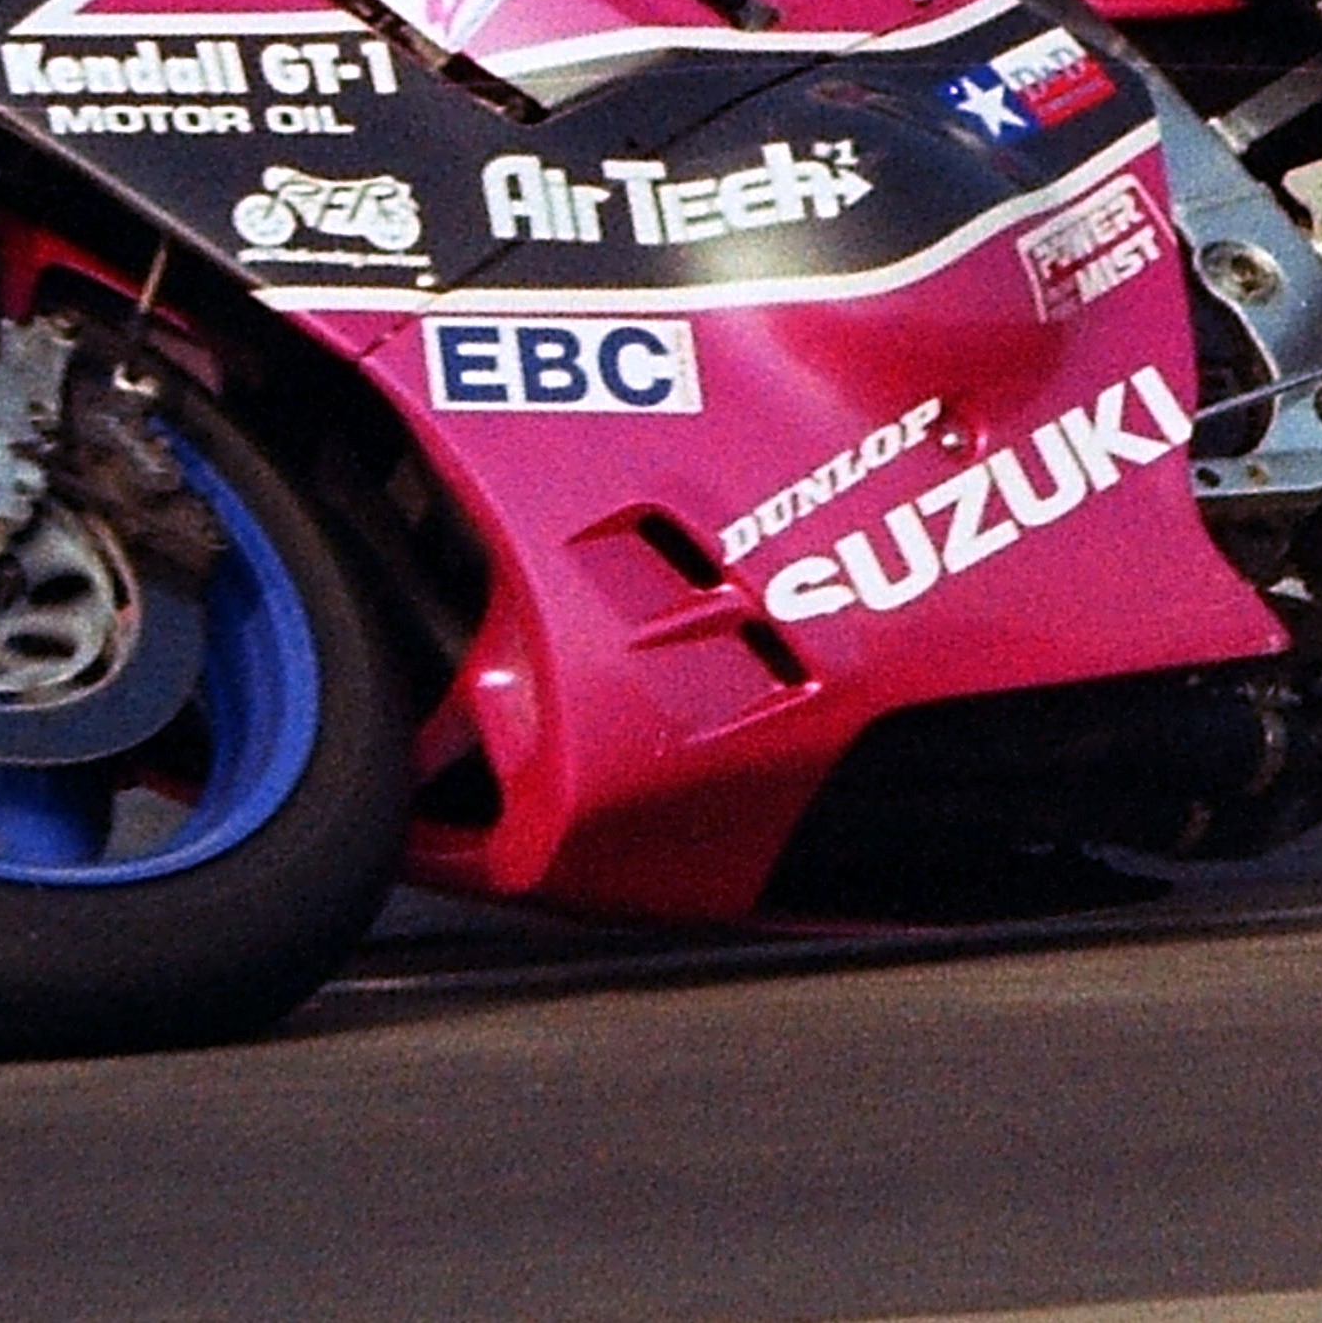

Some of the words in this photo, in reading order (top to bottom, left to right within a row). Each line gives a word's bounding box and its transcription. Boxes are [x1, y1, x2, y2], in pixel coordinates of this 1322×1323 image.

[0, 40, 250, 95] Kendall
[261, 40, 399, 95] GT-1
[46, 104, 254, 135] MOTOR
[265, 104, 357, 135] OIL
[1075, 224, 1161, 305] MIST
[437, 326, 674, 408] EBC
[718, 396, 943, 565] DUNLOP
[763, 364, 1195, 622] SUZUKI
